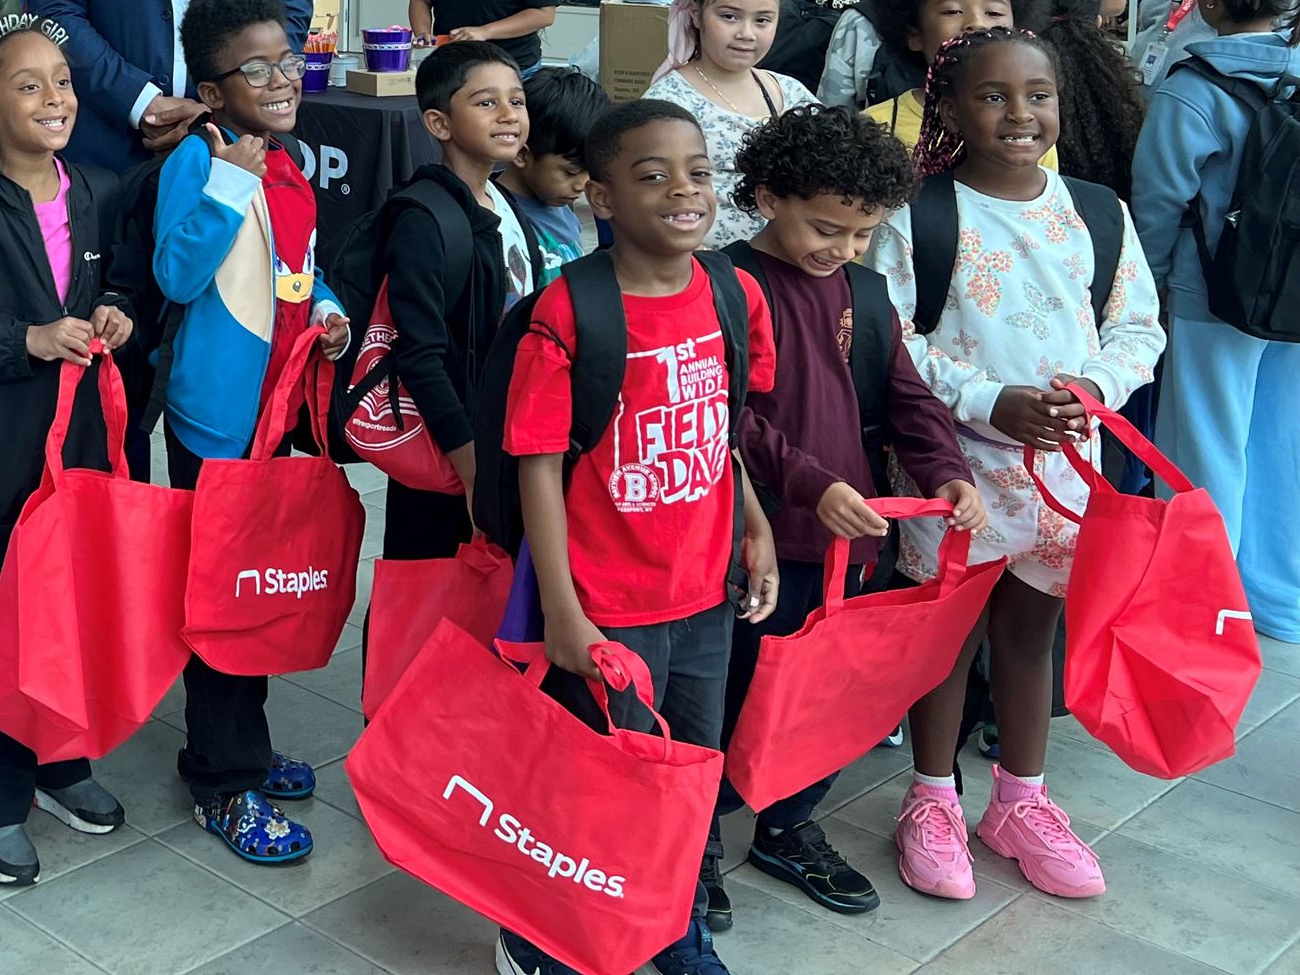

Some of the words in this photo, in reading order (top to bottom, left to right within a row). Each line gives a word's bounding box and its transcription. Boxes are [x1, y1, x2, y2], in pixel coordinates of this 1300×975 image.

[656, 338, 697, 404] 1st
[679, 355, 718, 375] ANNUAL
[680, 365, 723, 386] BUILDING
[636, 396, 729, 464] FIELD
[624, 472, 647, 502] B
[655, 438, 728, 504] DAY
